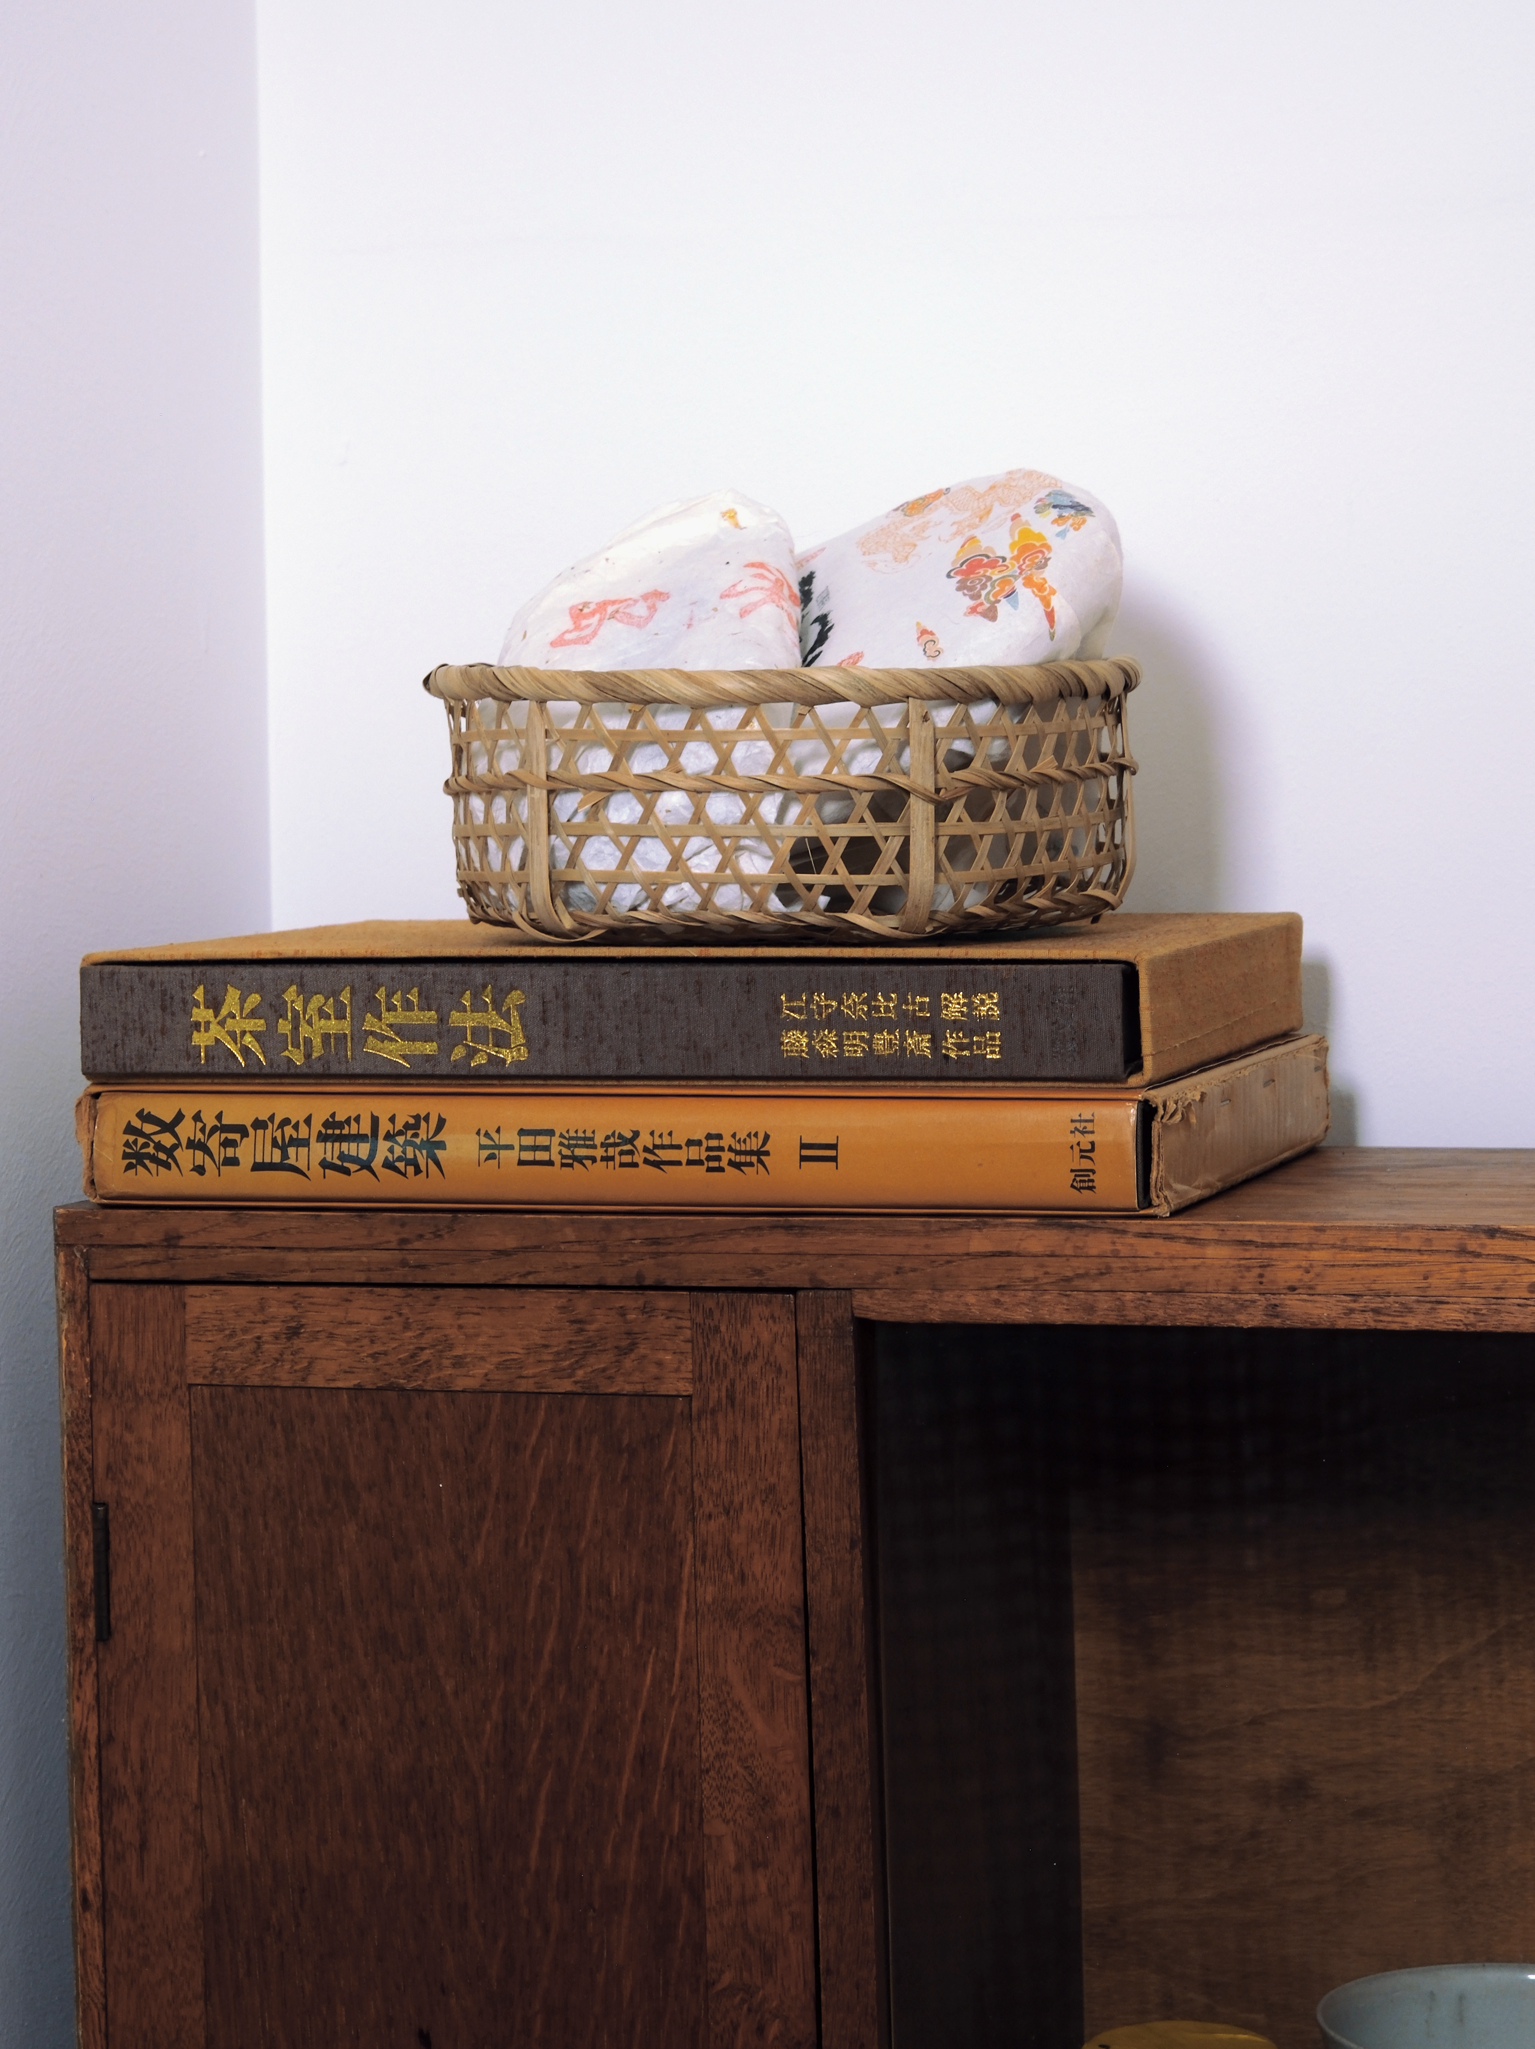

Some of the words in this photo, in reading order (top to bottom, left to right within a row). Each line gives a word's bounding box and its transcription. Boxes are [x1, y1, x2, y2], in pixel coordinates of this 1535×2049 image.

[191, 984, 527, 1068] 茶室作法
[780, 991, 930, 1021] 江守奈比古
[940, 991, 1001, 1021] 解説
[942, 1028, 1002, 1060] 作品
[121, 1107, 447, 1183] 数寄屋建築
[476, 1125, 771, 1175] 平田雅哉作品集
[1069, 1112, 1097, 1195] 創元社
